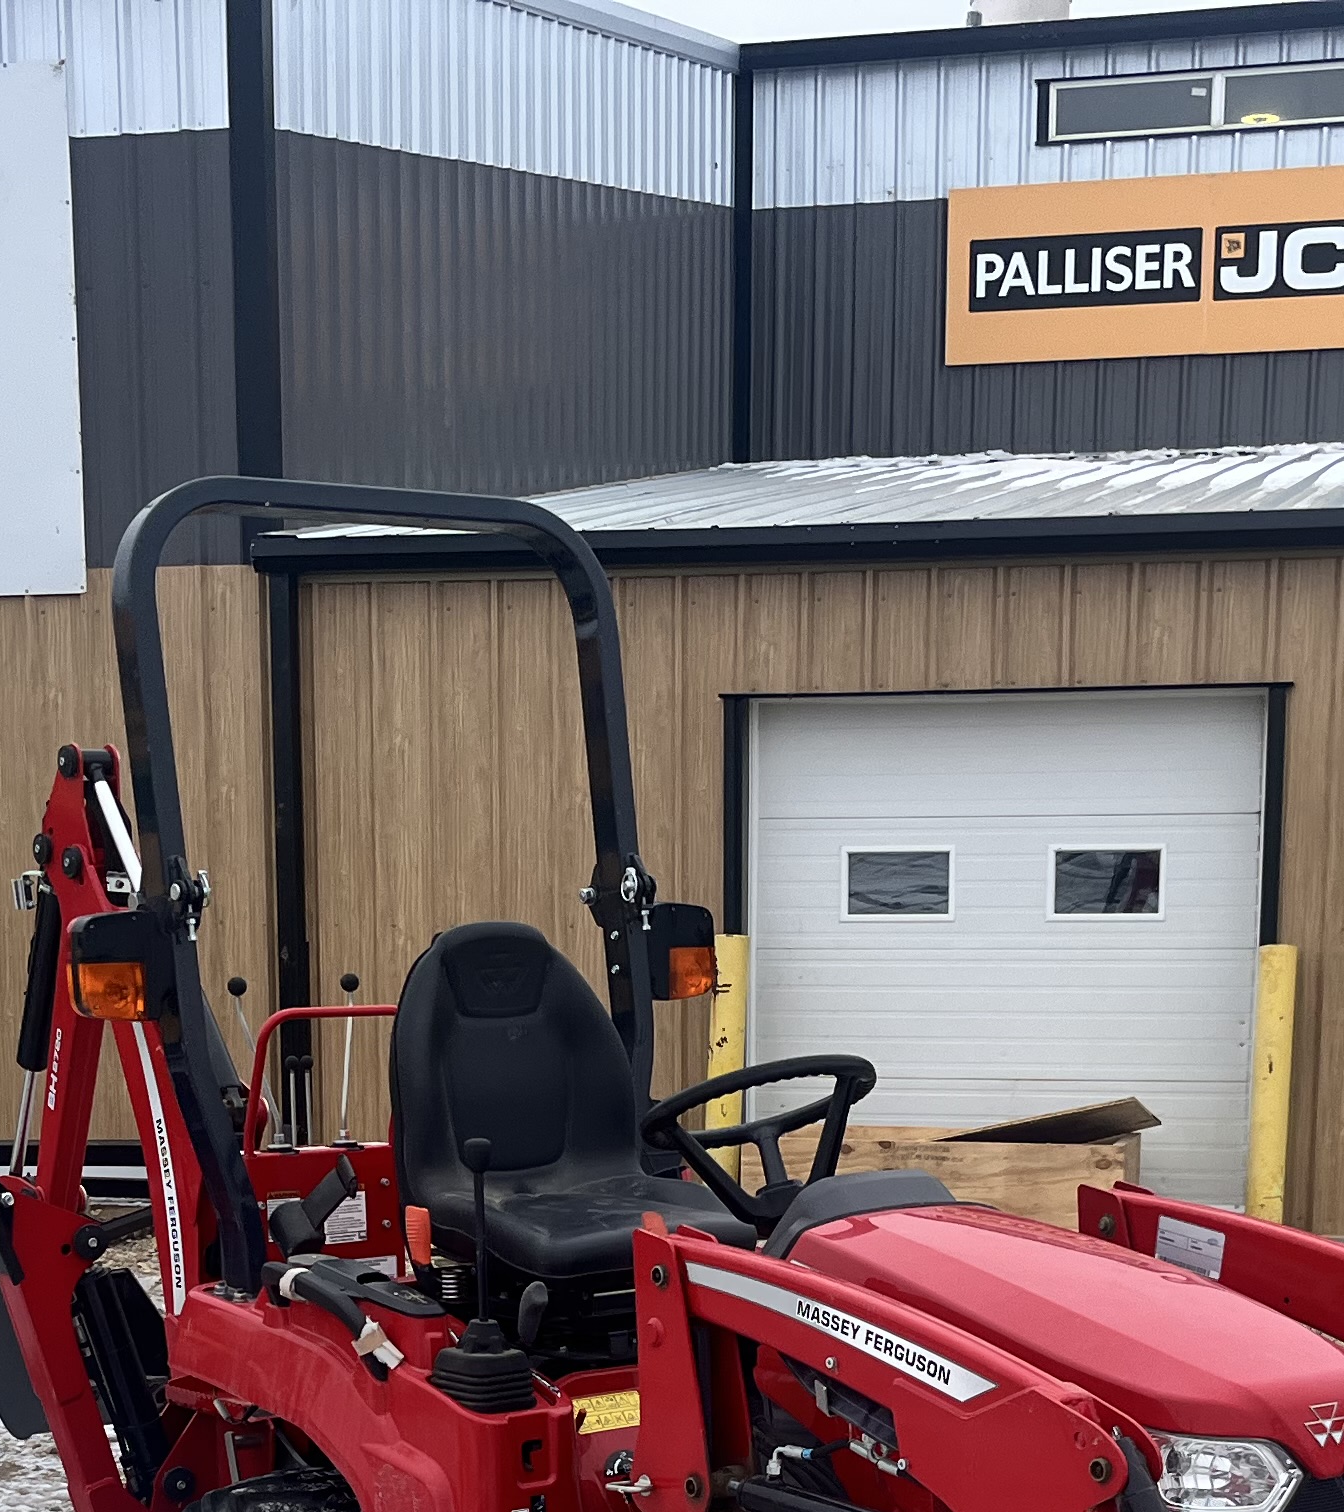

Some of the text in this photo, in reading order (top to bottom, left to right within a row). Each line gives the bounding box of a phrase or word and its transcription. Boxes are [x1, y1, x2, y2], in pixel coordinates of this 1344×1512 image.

[974, 241, 1196, 299] PALLISER
[155, 1118, 182, 1289] MASSEY FERGUSON
[796, 1299, 951, 1386] MASSEY FERGUSON
